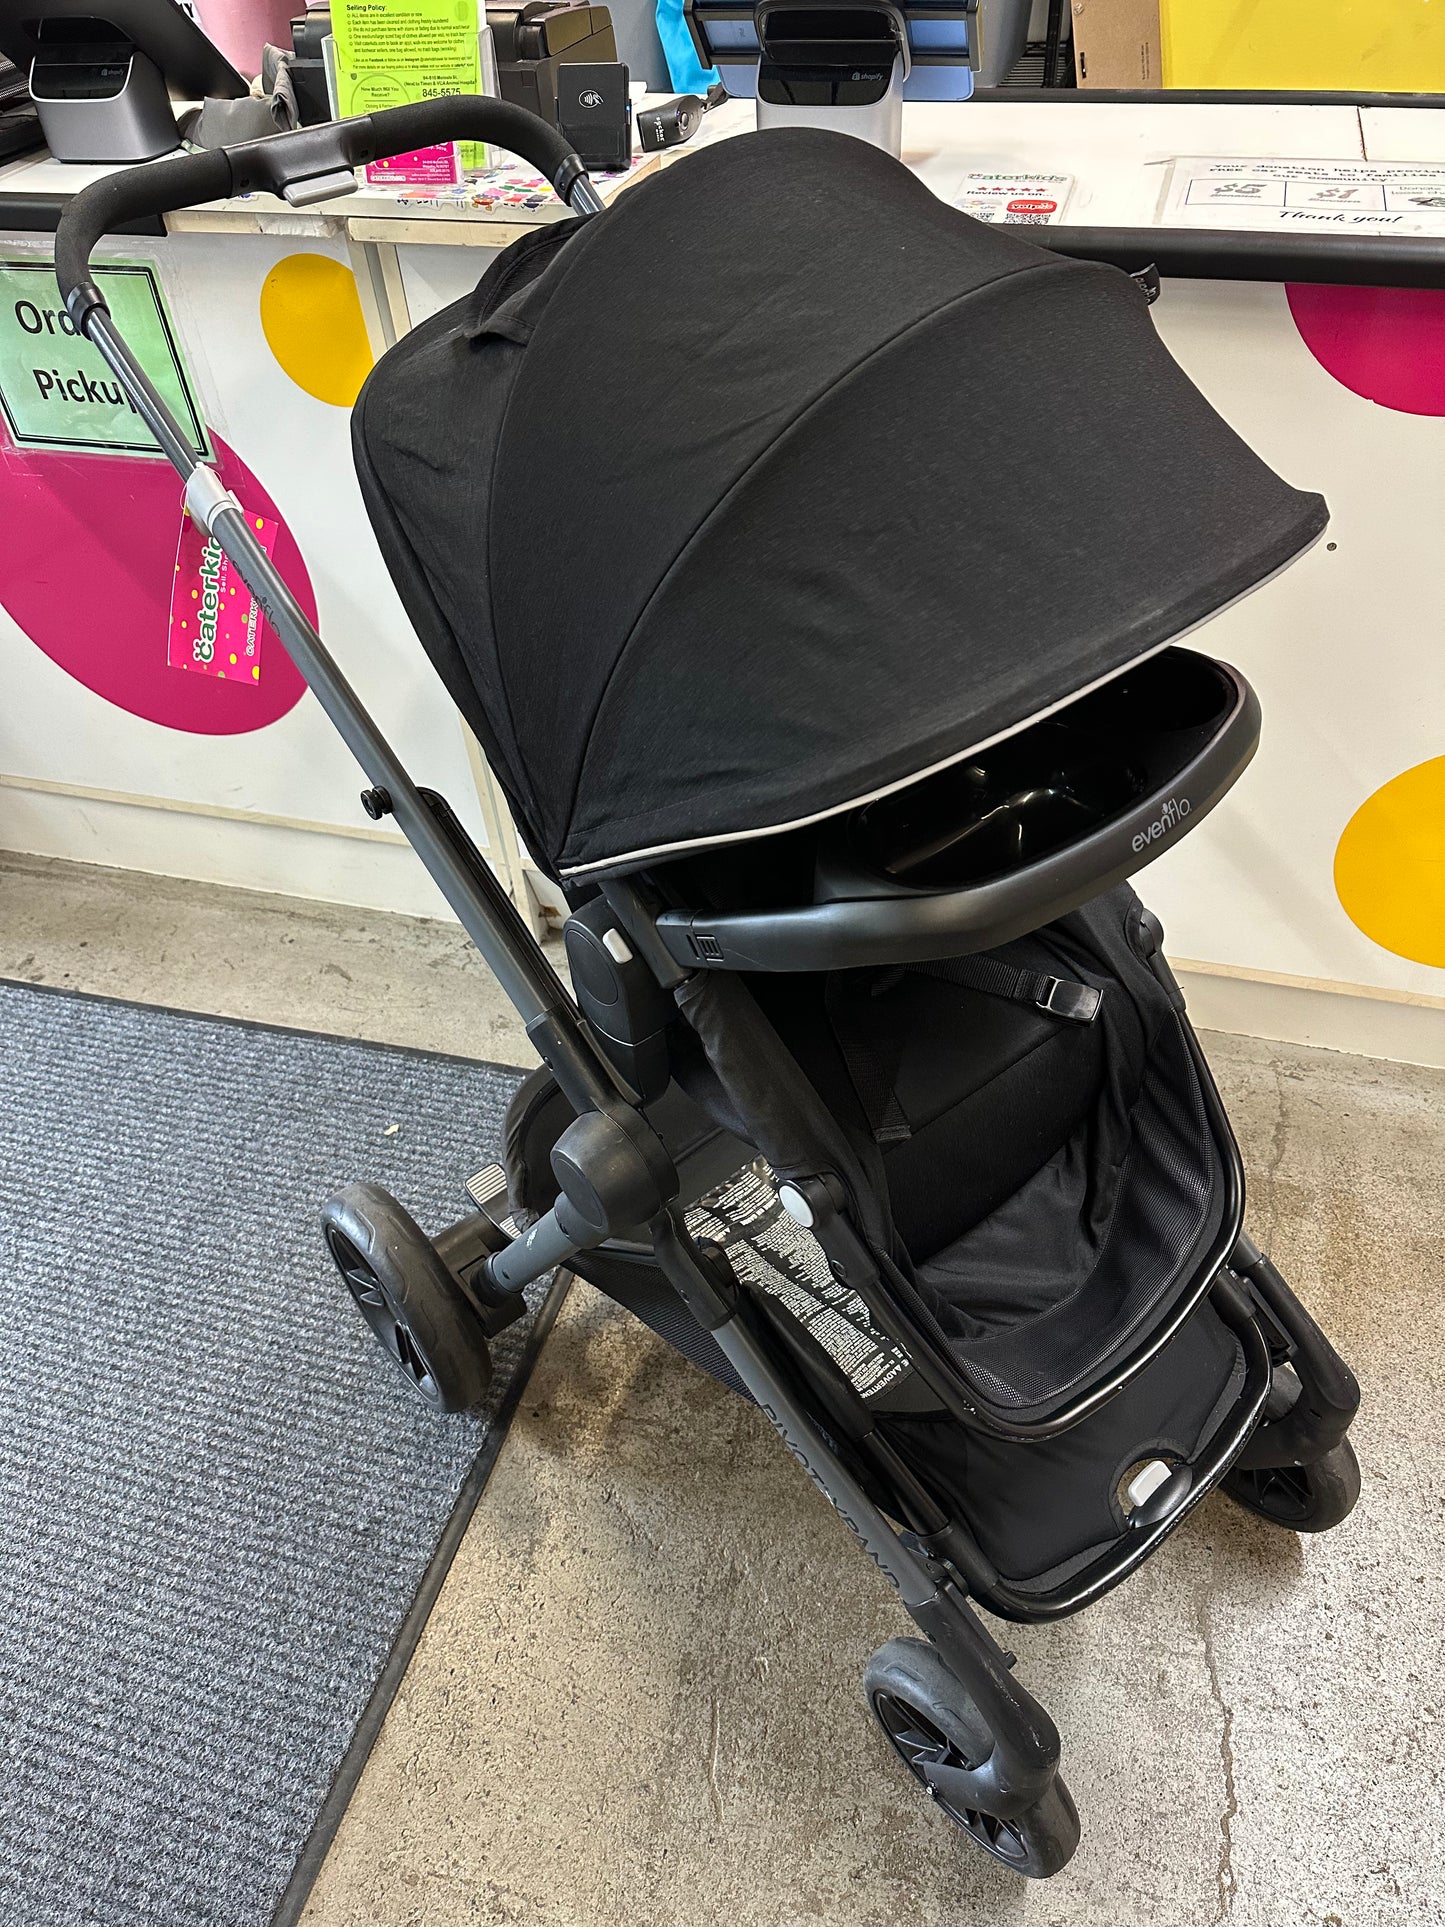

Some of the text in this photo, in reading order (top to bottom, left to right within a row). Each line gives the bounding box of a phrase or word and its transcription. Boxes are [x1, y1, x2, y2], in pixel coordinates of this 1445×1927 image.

[422, 88, 461, 98] 845-5575
[1214, 183, 1267, 194] $5
[1316, 188, 1359, 199] $1
[1280, 210, 1345, 221] Thank
[14, 301, 80, 336] Ord
[32, 369, 138, 414] Picku
[246, 598, 258, 657] CATERK
[1132, 798, 1190, 852] evenflo
[763, 1403, 824, 1484] PIVOT
